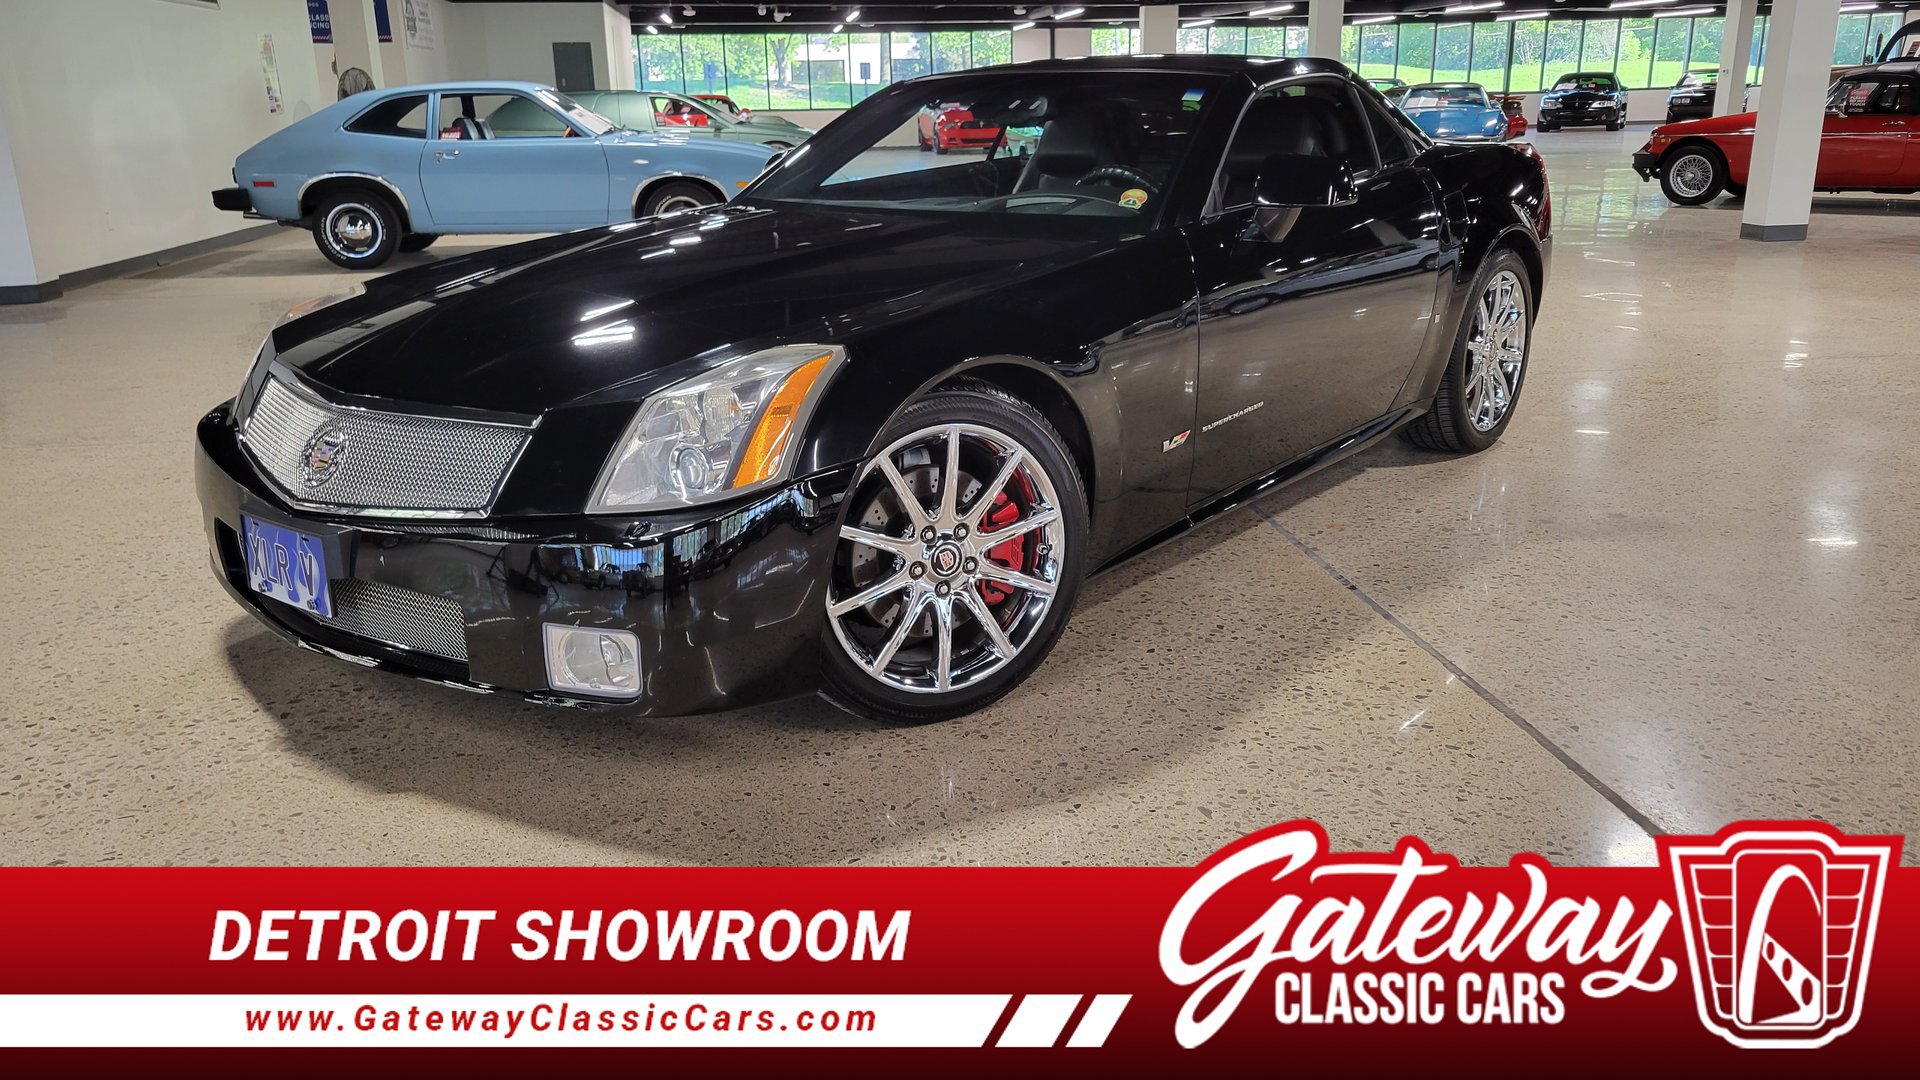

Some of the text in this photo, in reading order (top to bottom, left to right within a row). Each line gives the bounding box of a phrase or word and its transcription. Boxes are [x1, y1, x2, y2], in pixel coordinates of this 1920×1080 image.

[1202, 401, 1264, 432] SUPERCHARGED
[248, 532, 314, 597] XLR V
